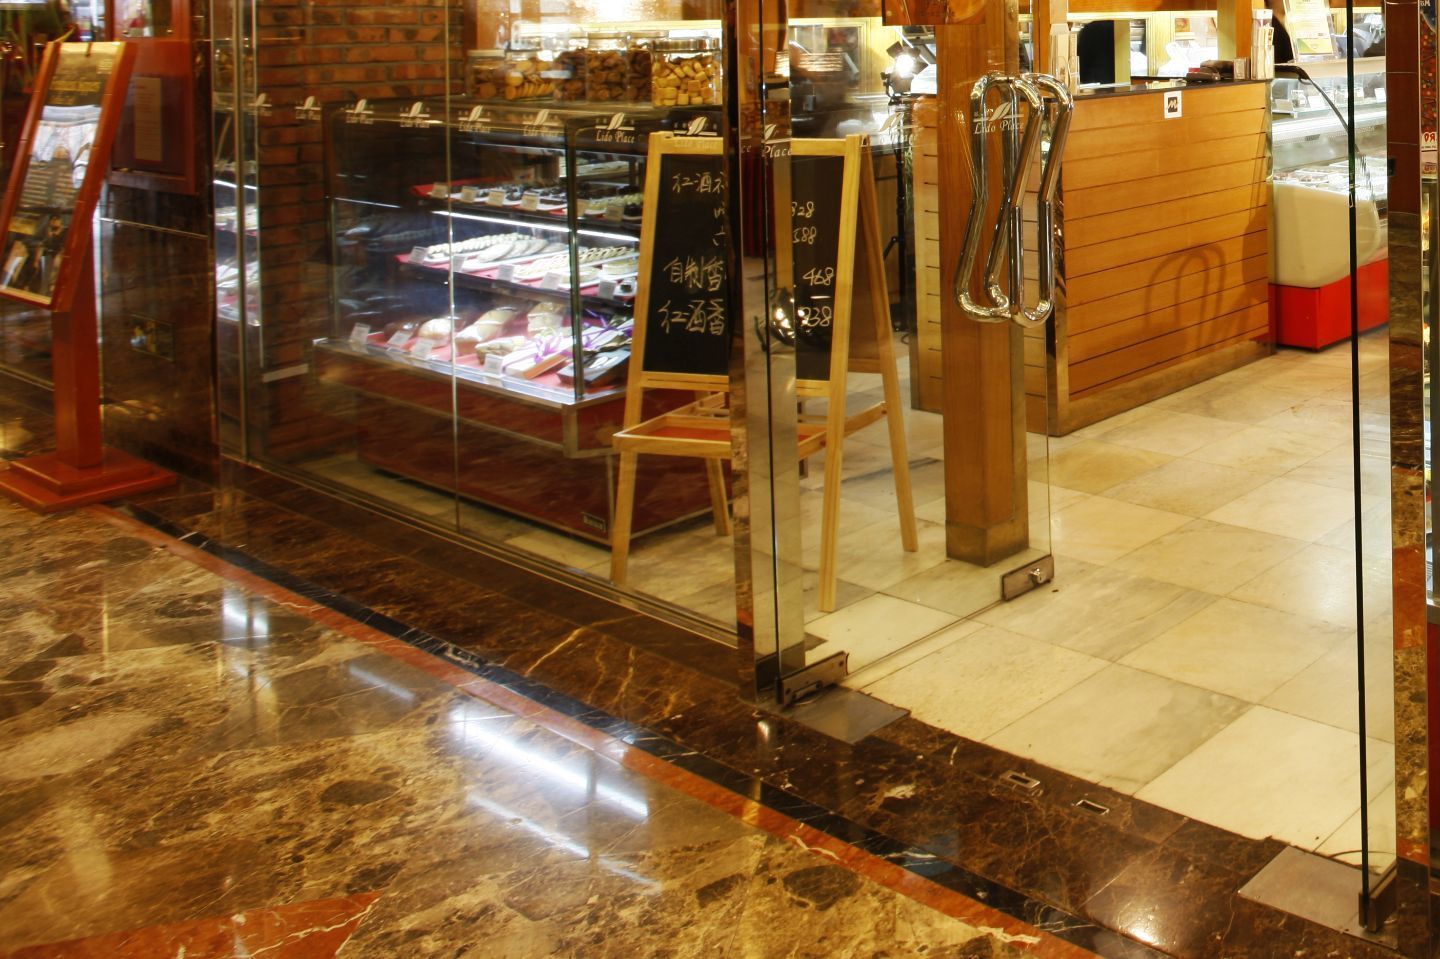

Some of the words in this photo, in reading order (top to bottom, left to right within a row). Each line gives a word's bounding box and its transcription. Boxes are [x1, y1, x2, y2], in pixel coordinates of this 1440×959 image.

[596, 129, 613, 142] Lido
[614, 131, 635, 144] Place
[802, 266, 835, 287] 468
